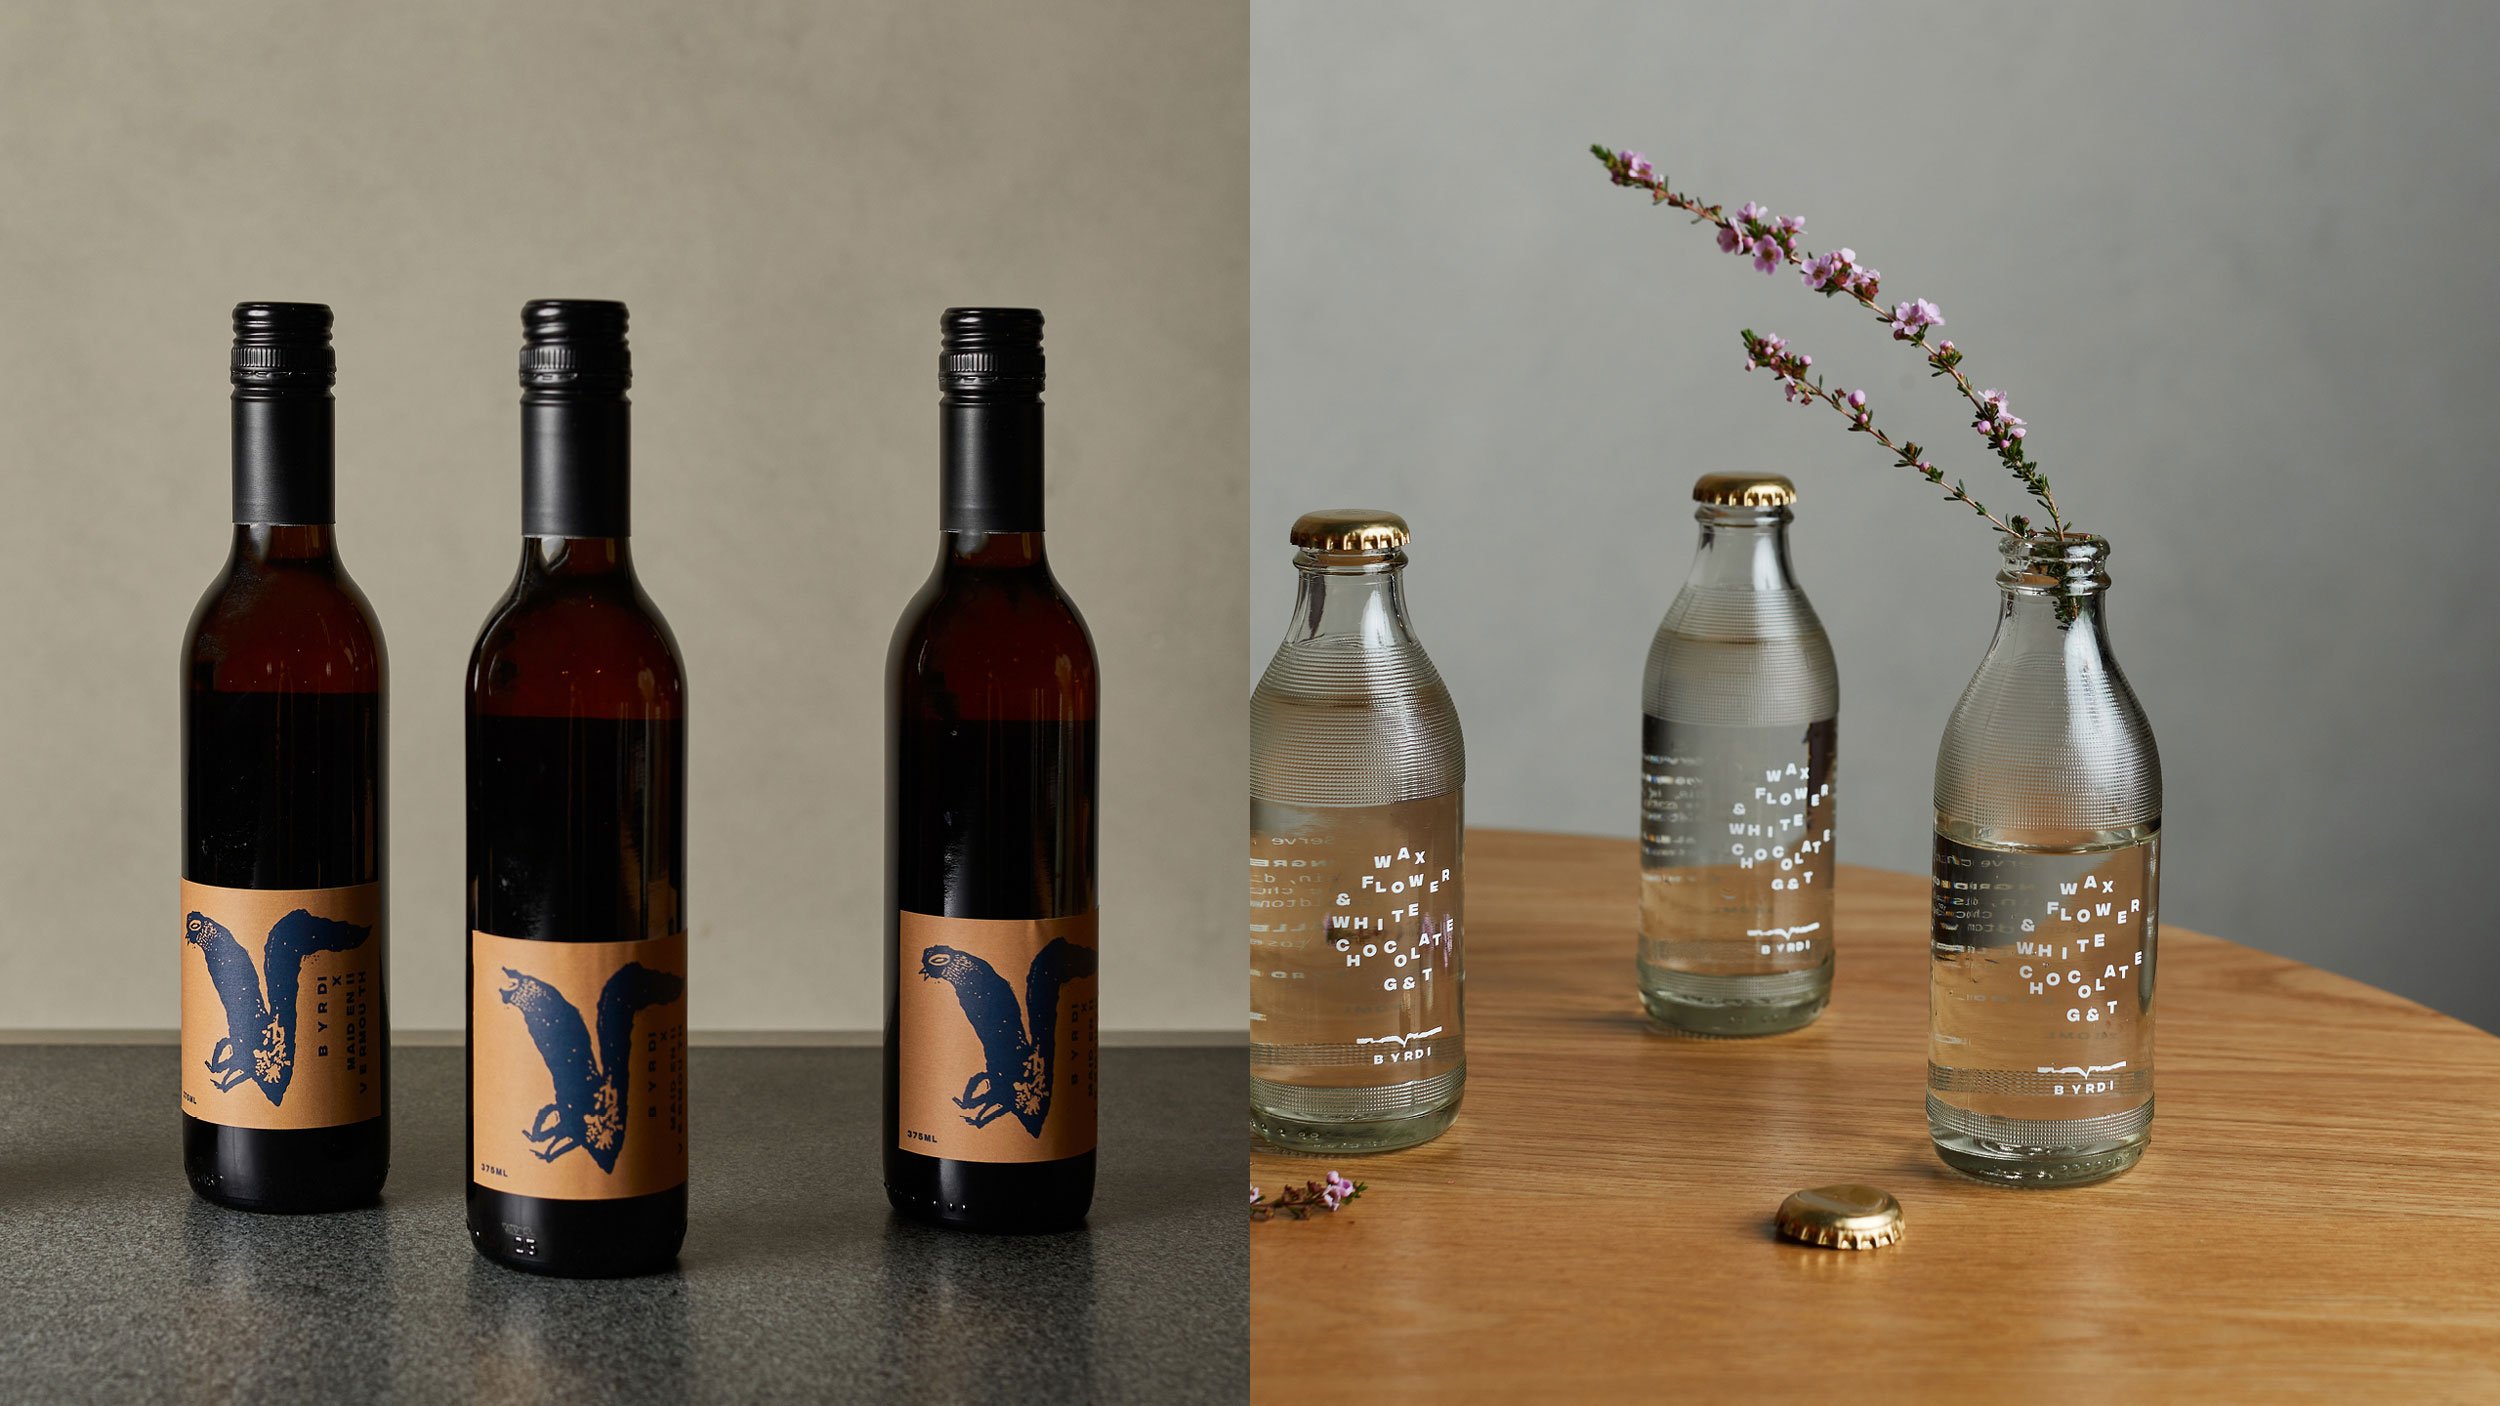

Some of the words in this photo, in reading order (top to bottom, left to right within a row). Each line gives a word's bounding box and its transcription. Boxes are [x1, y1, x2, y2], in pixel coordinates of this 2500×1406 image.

[1766, 763, 1810, 783] WAX
[1756, 784, 1829, 806] FLOWER
[1732, 803, 1746, 816] &
[1729, 814, 1804, 837] WHITE
[1375, 847, 1426, 869] WAX
[1732, 830, 1830, 869] CHOCOLATE
[1362, 869, 1450, 893] FLOWER
[1771, 872, 1813, 891] G&T
[2060, 875, 2114, 895] WAX
[1336, 893, 1350, 906] &
[1332, 903, 1419, 931] WHITE
[2047, 899, 2140, 925] FLOWER
[2021, 918, 2035, 932] &
[1336, 919, 1454, 967] CHOCOLATE
[1761, 940, 1810, 955] BYRDI
[2017, 934, 2105, 960] WHITE
[332, 975, 342, 987] X
[1384, 968, 1433, 991] G&T
[2020, 952, 2142, 999] CHOCOLATE
[317, 976, 328, 1057] BYRDI
[2066, 1000, 2118, 1022] G&T
[1373, 1047, 1431, 1065] BYRDI
[2054, 1080, 2114, 1095] BYRDI
[907, 1130, 938, 1143] 375ML
[480, 1163, 508, 1178] 375ML
